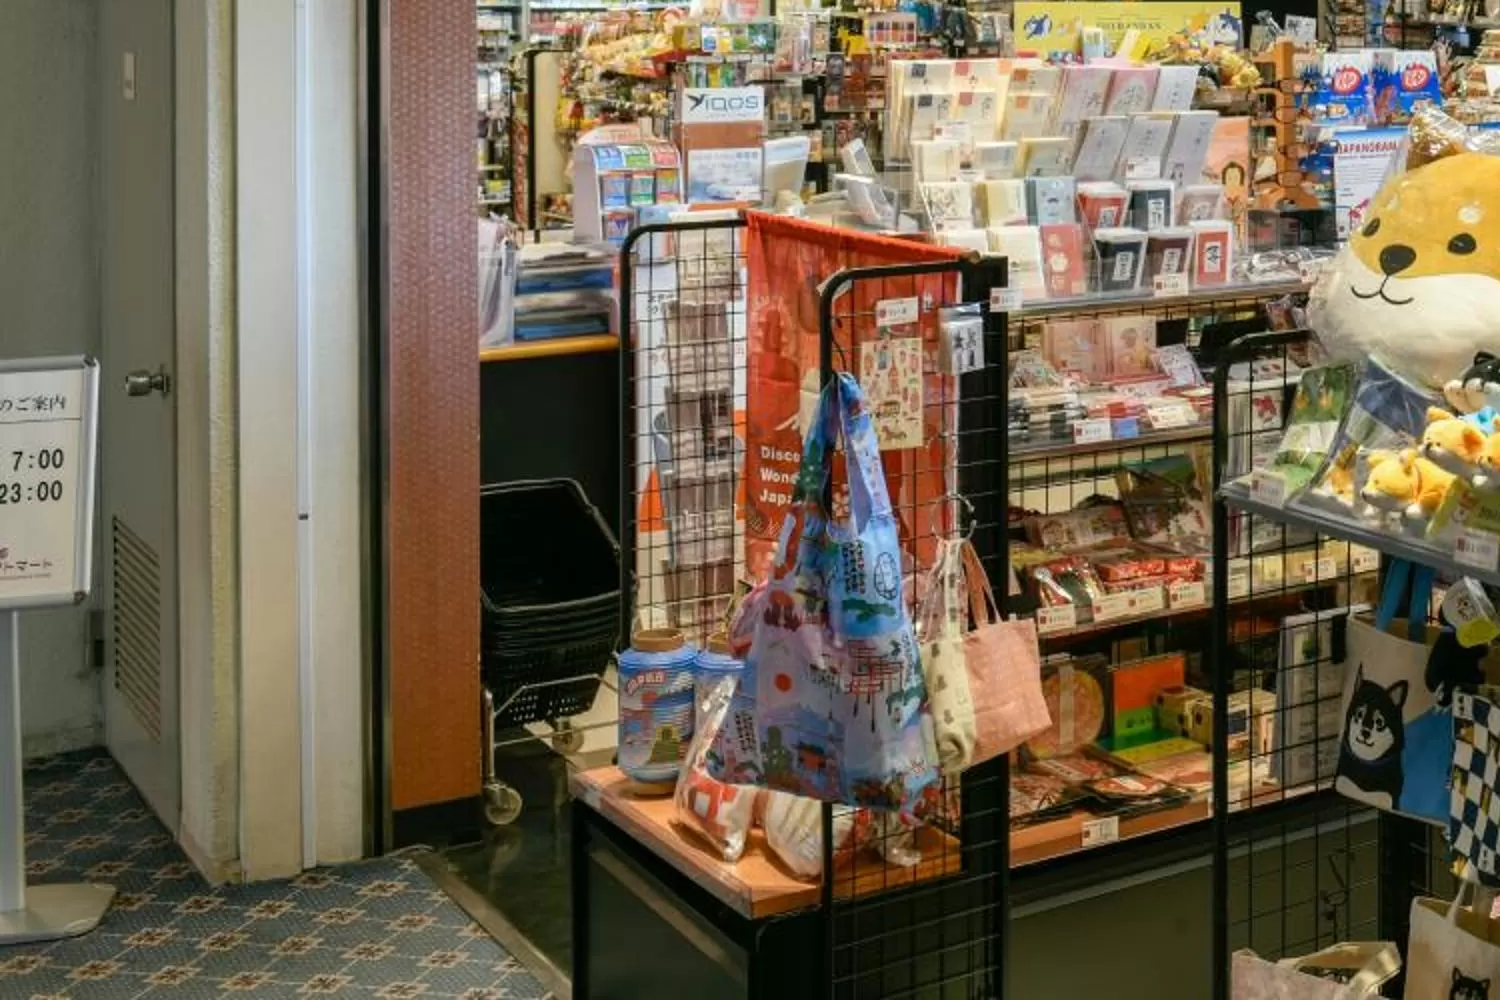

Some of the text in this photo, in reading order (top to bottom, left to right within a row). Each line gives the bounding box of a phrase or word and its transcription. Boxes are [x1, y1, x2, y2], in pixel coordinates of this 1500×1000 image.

[12, 448, 64, 471] 7:00
[761, 445, 800, 462] Disco
[0, 480, 63, 504] 23:00
